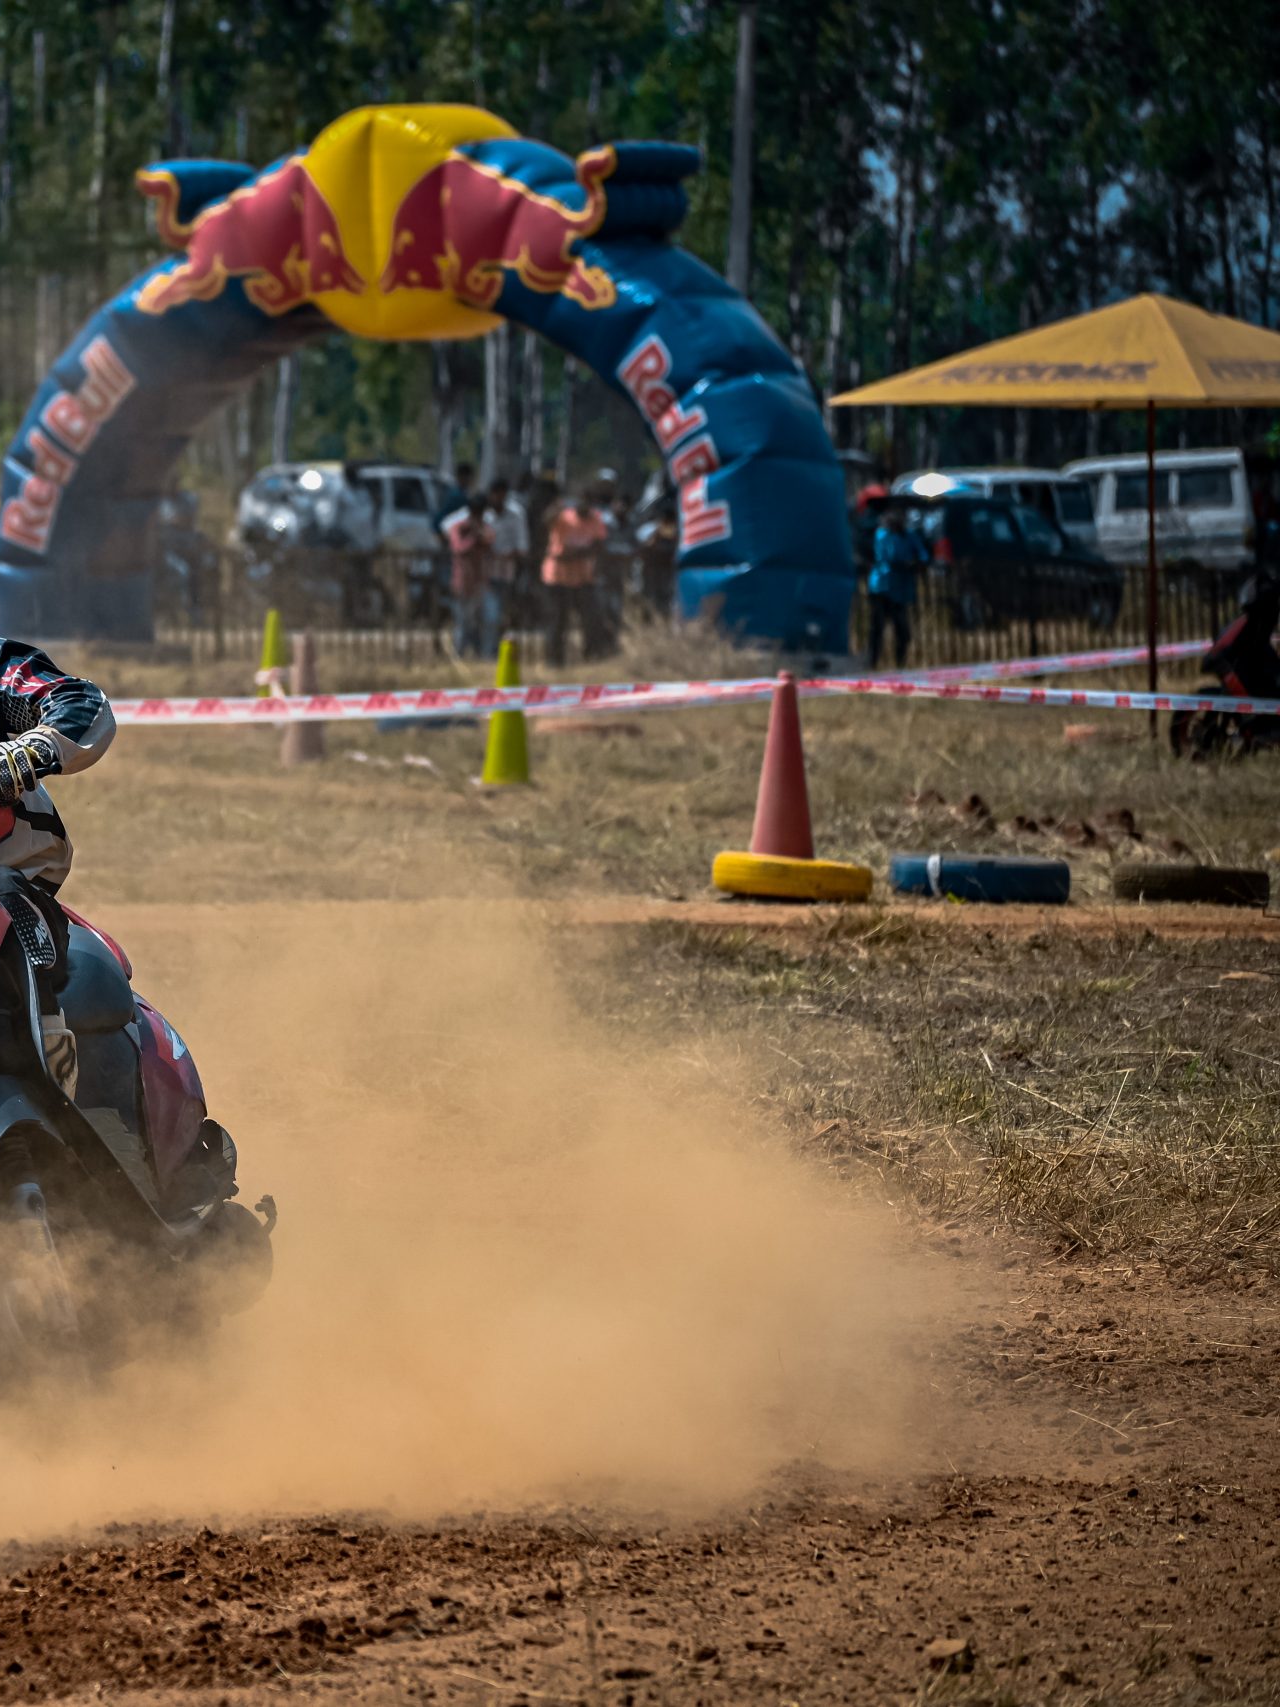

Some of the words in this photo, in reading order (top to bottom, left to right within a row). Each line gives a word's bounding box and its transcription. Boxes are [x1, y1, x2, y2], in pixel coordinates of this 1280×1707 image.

[0, 425, 77, 553] Red
[41, 335, 136, 453] Bull
[616, 335, 708, 449] Red
